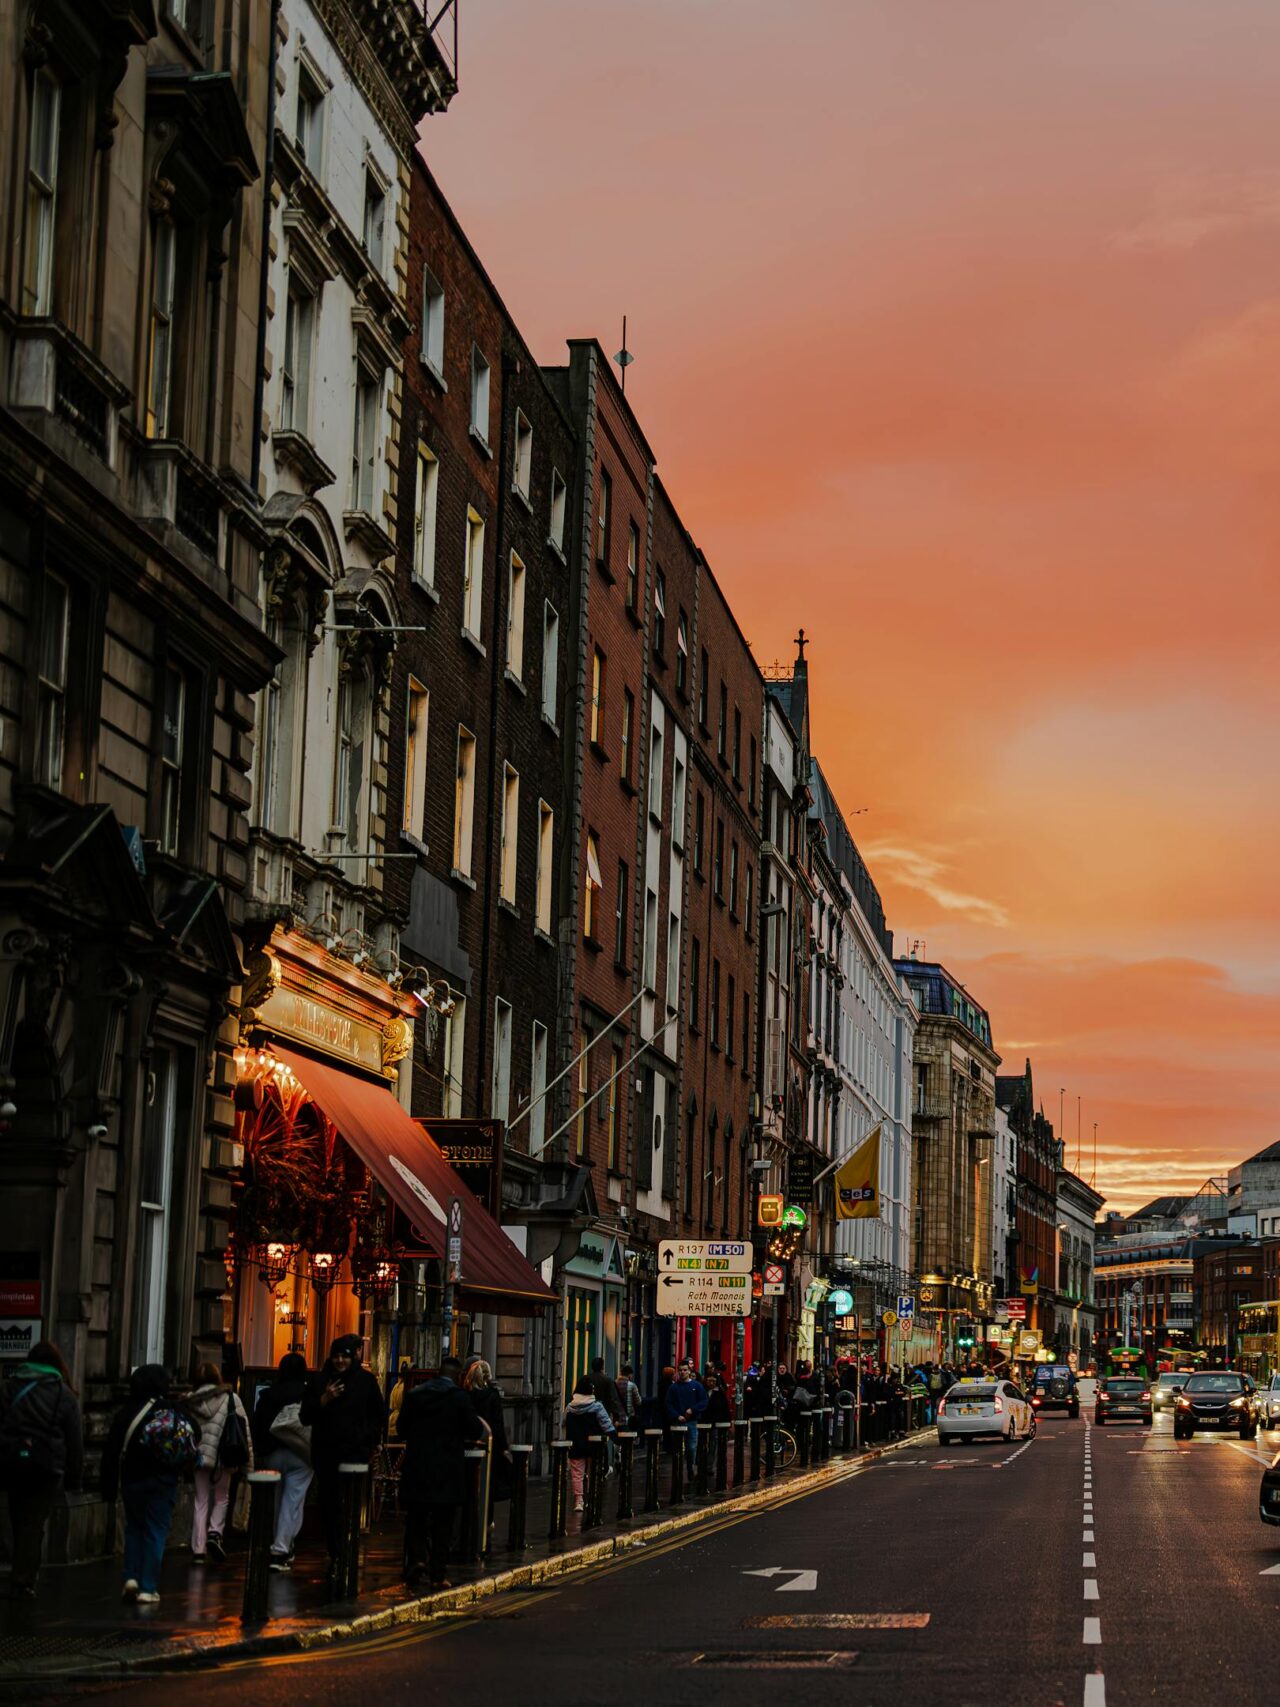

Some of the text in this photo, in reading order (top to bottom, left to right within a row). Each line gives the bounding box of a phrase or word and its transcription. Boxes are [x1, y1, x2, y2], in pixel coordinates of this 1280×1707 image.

[840, 1190, 872, 1198] ces
[678, 1245, 685, 1254] R
[686, 1245, 704, 1254] 137
[726, 1245, 743, 1255] 50)
[689, 1277, 696, 1286] R
[697, 1277, 713, 1286] 114
[688, 1302, 743, 1312] RATHMINES
